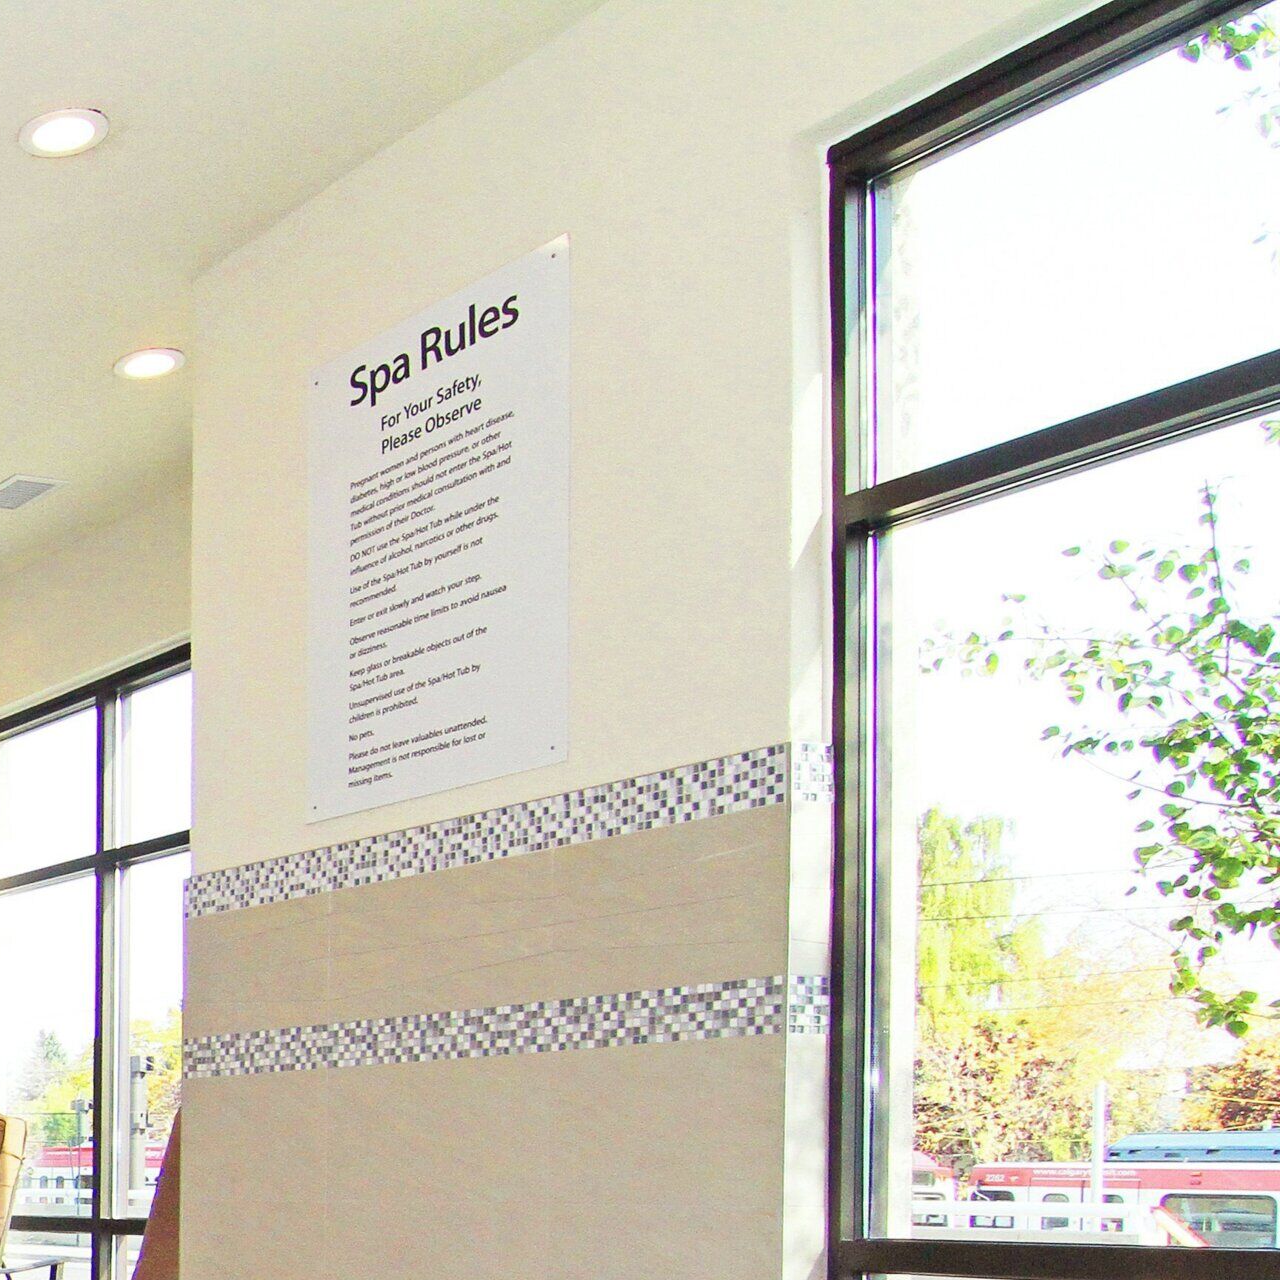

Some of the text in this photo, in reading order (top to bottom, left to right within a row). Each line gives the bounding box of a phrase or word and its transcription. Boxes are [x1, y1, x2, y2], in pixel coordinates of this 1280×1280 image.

[349, 294, 520, 408] Spa Rules
[380, 373, 482, 432] For Your Safety,
[381, 397, 482, 455] Please Observe
[349, 410, 515, 491] Pregnant women and persons with heart disease,
[349, 430, 502, 505] diabetes, high or low blood pressure, or other
[350, 440, 513, 518] medical conditions should not enter the Spa/Hot
[350, 454, 512, 532] Tub without prior medical consultation with and
[349, 503, 437, 548] permission of their Doctor.
[349, 495, 500, 564] DO NOT use the Spa/Hot Tub while under the
[349, 511, 500, 577] influence of alcohol, narcotics or other drugs.
[349, 536, 484, 595] Use of the Spa/Hot Tub by yourself is not
[349, 583, 398, 609] recommended.
[349, 573, 482, 628] Enter or exit slowly and watch your step.
[349, 584, 508, 647] Observe reasonable time limits to avoid nausea
[348, 641, 388, 660] or dizziness.
[349, 626, 488, 678] Keep glass or breakable objects out of the
[348, 663, 481, 711] Unsupervised use of the Spa/Hot Tub by
[349, 668, 406, 692] Spa/Hot Tub area.
[348, 695, 419, 725] children is prohibited.
[348, 729, 375, 743] No pets.
[348, 714, 488, 761] Please do not leave valuables unattended.
[347, 771, 394, 789] missing items.
[348, 731, 487, 775] Management is not responsible for lost or
